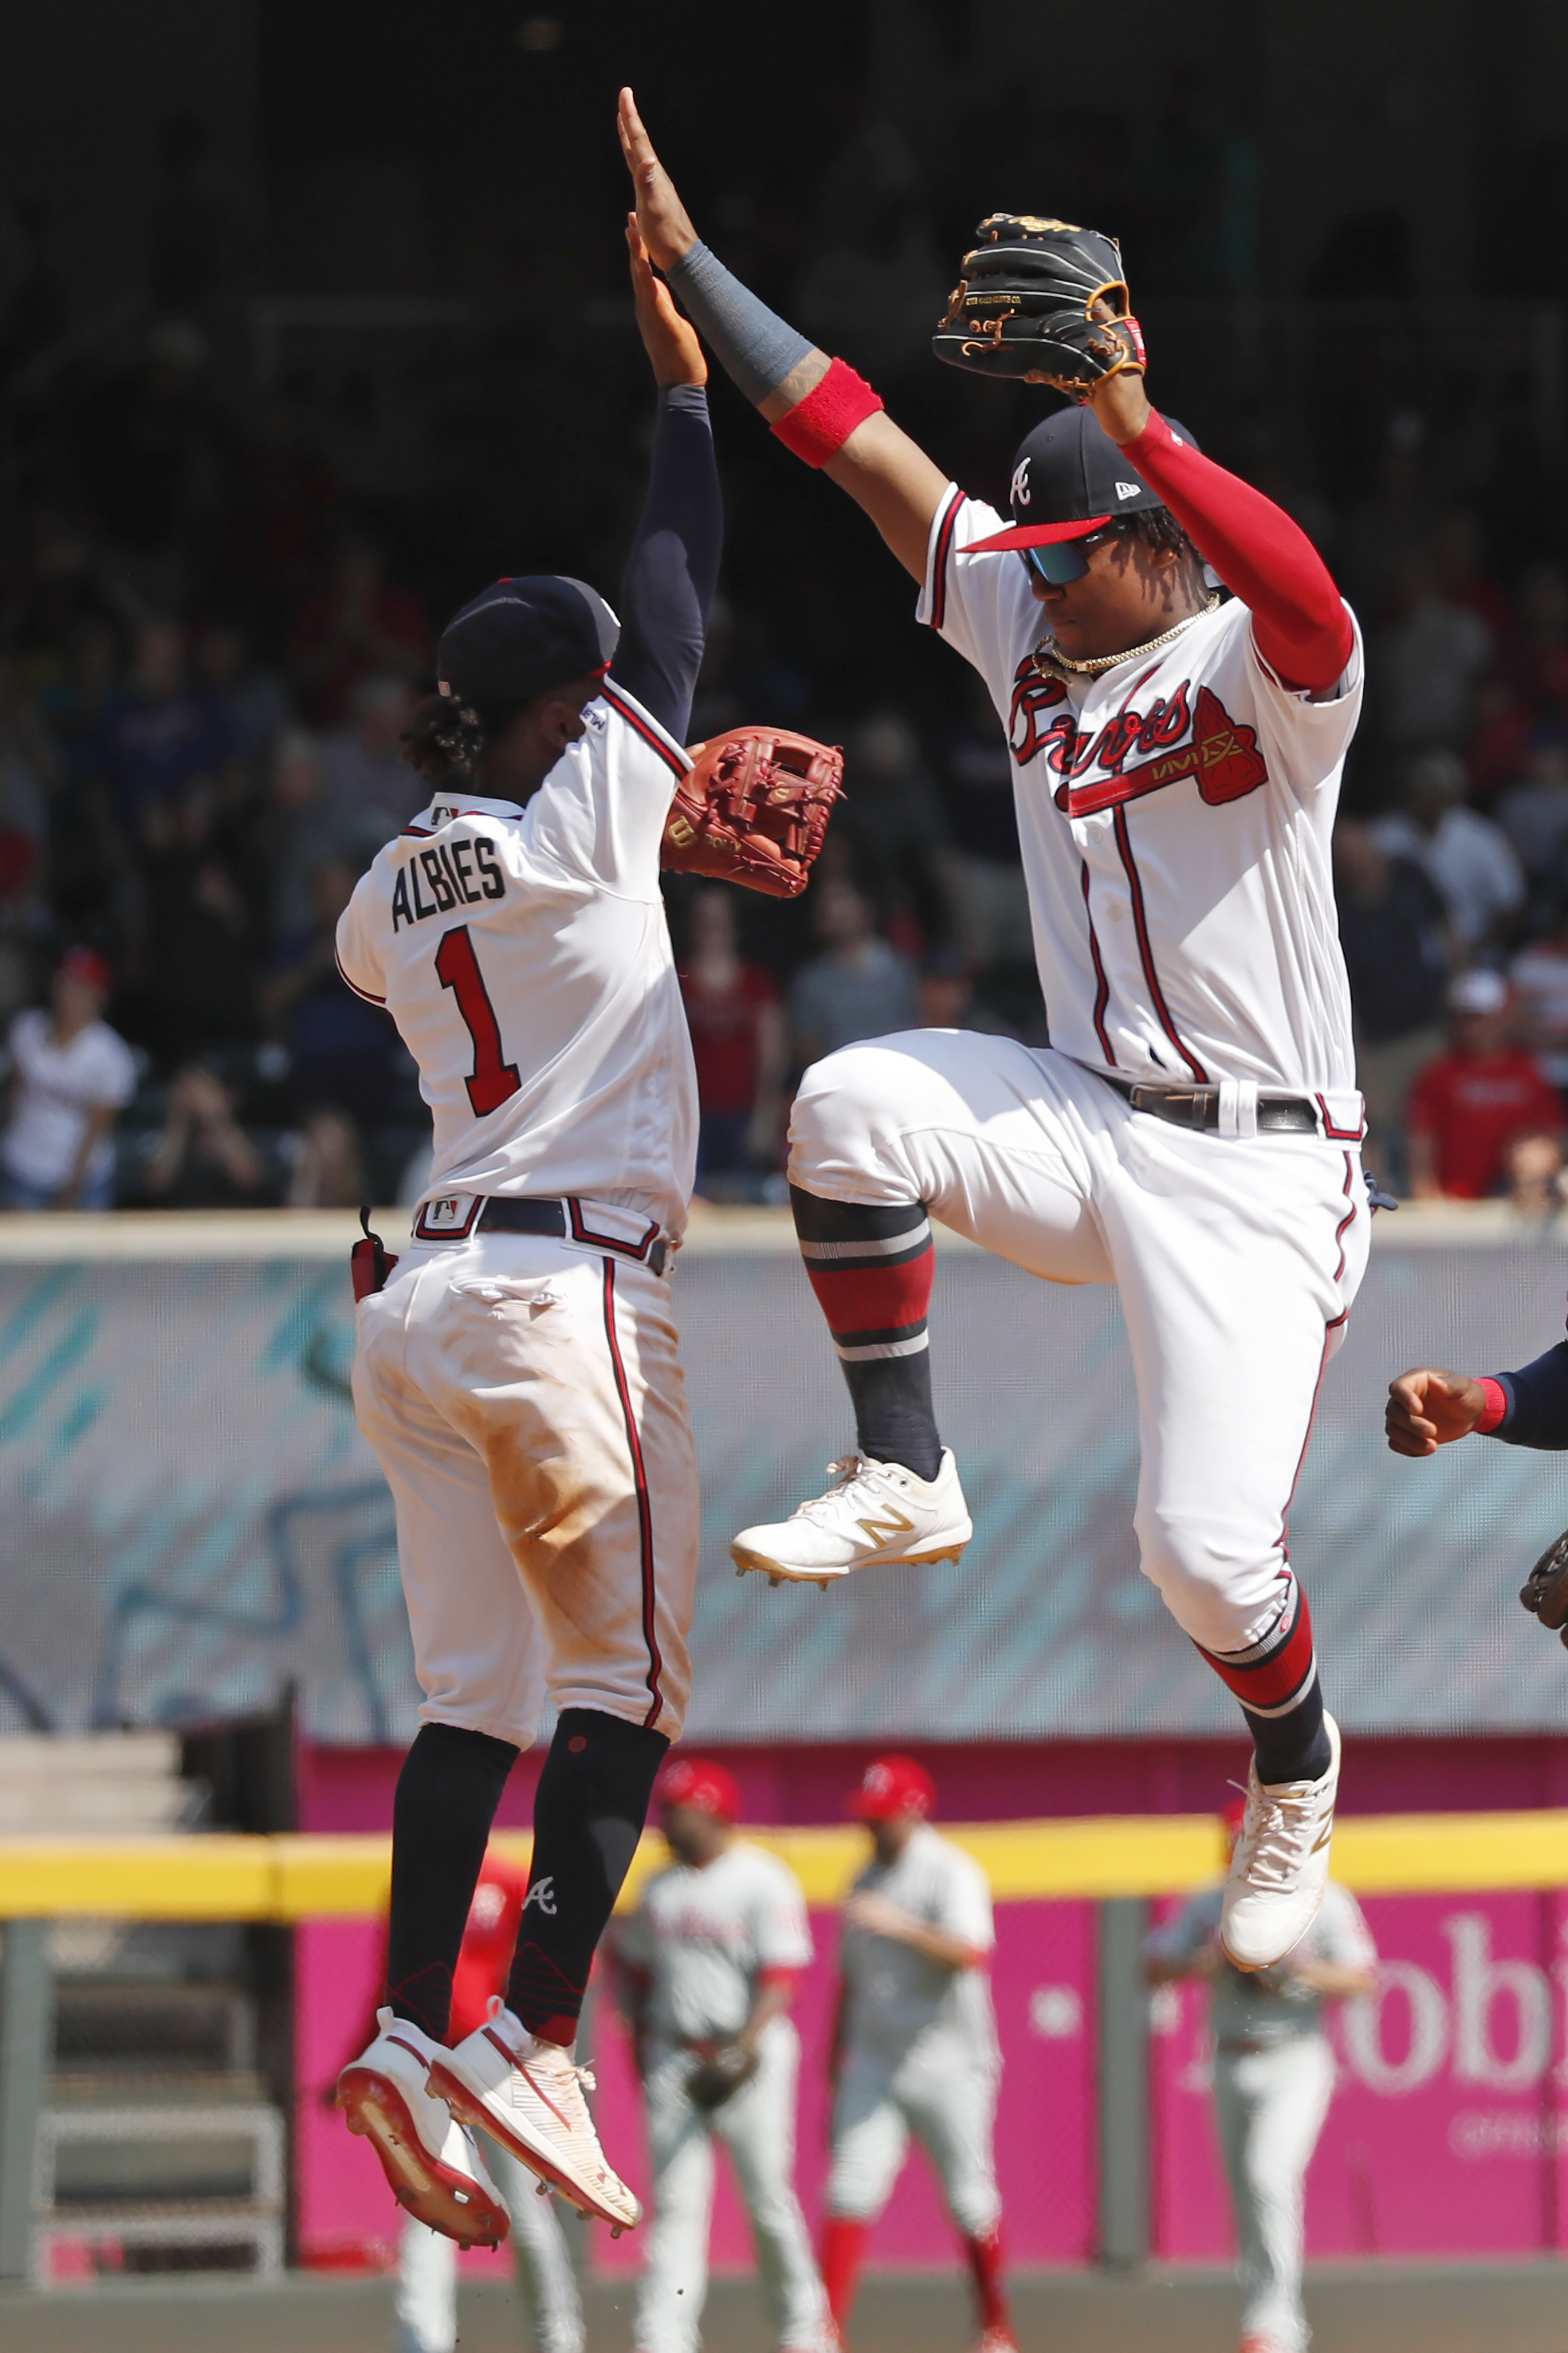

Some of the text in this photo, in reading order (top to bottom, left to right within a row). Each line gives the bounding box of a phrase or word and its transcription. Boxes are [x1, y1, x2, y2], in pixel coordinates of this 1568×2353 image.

[392, 837, 506, 934] ALBIES
[434, 923, 522, 1119] 1
[855, 1503, 915, 1547] N
